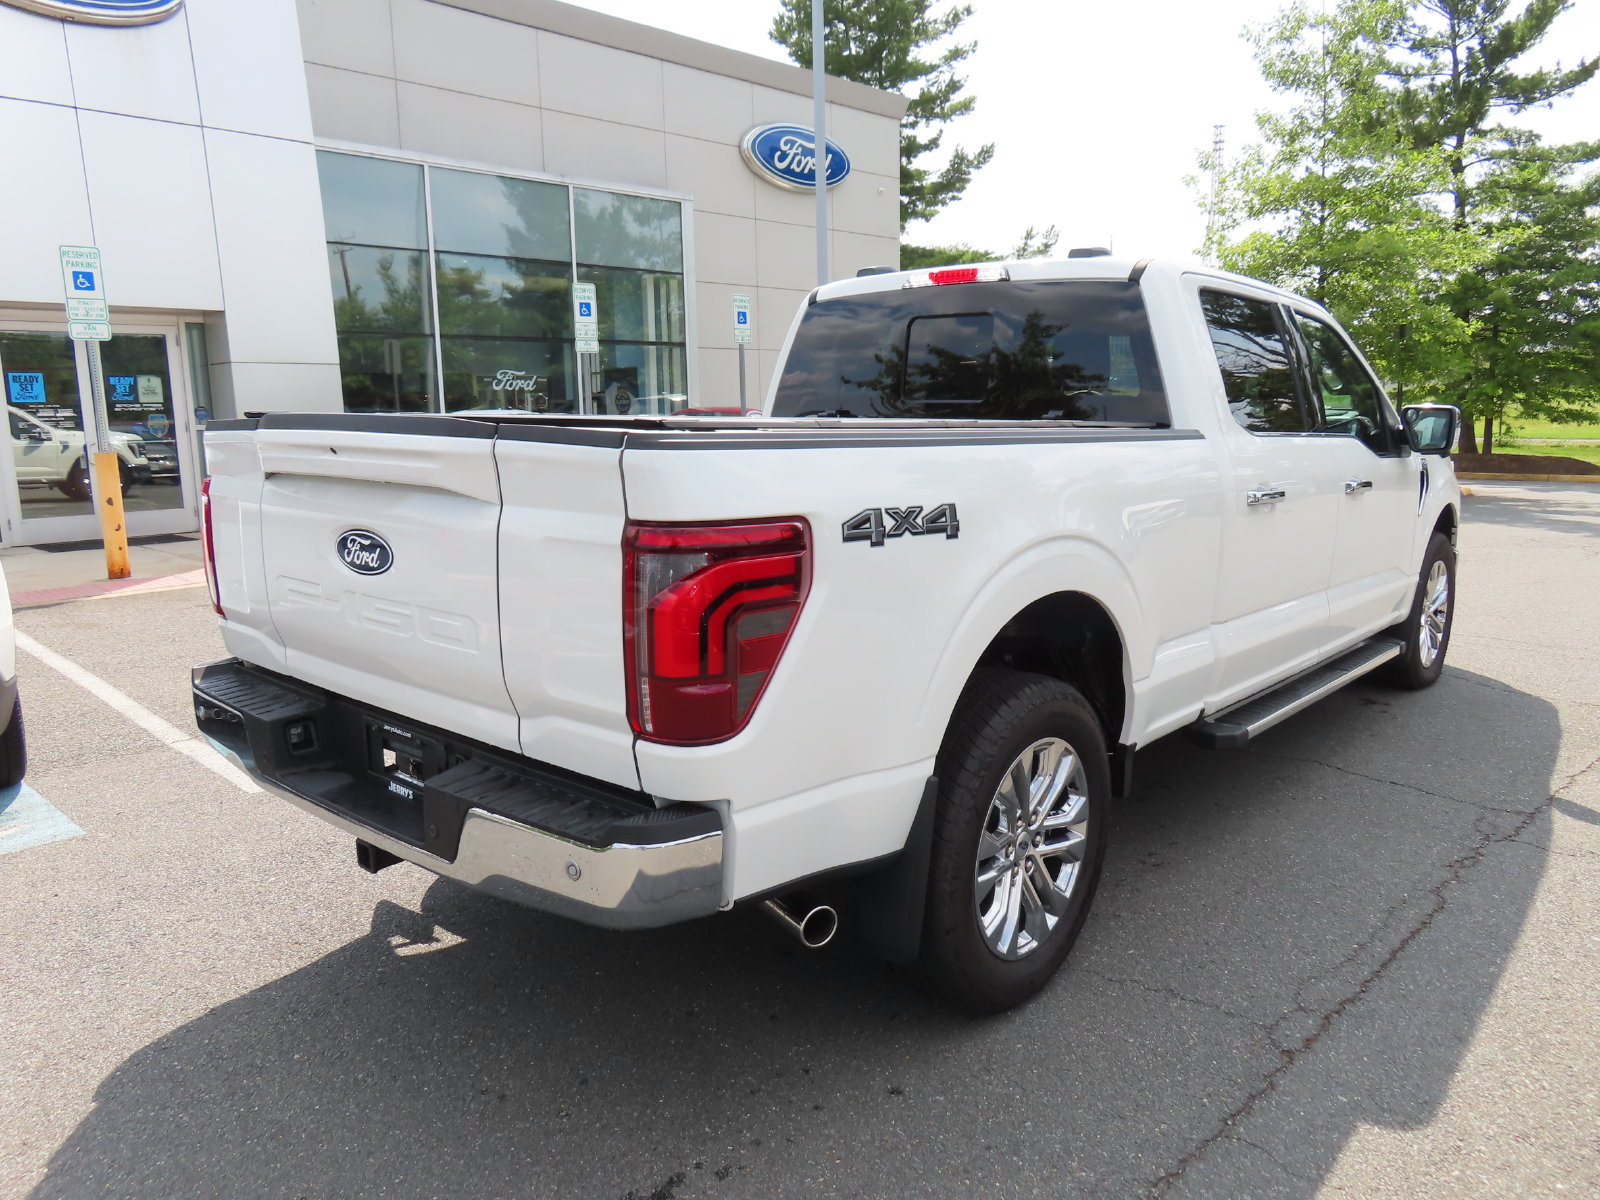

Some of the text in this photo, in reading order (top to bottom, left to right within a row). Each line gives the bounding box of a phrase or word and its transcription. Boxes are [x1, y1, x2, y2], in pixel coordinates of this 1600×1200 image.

[62, 250, 98, 259] RESERVED
[65, 260, 97, 269] PARKING
[12, 375, 39, 383] READY
[109, 376, 135, 385] READY
[492, 369, 537, 391] Ford
[19, 383, 34, 391] SET
[116, 385, 130, 393] SET
[15, 392, 40, 400] Ford
[112, 392, 136, 400] Ford
[344, 535, 380, 568] Ford
[276, 575, 479, 655] F-150
[383, 724, 412, 738] JerrysAuto.com
[388, 781, 414, 799] JERRY'S
